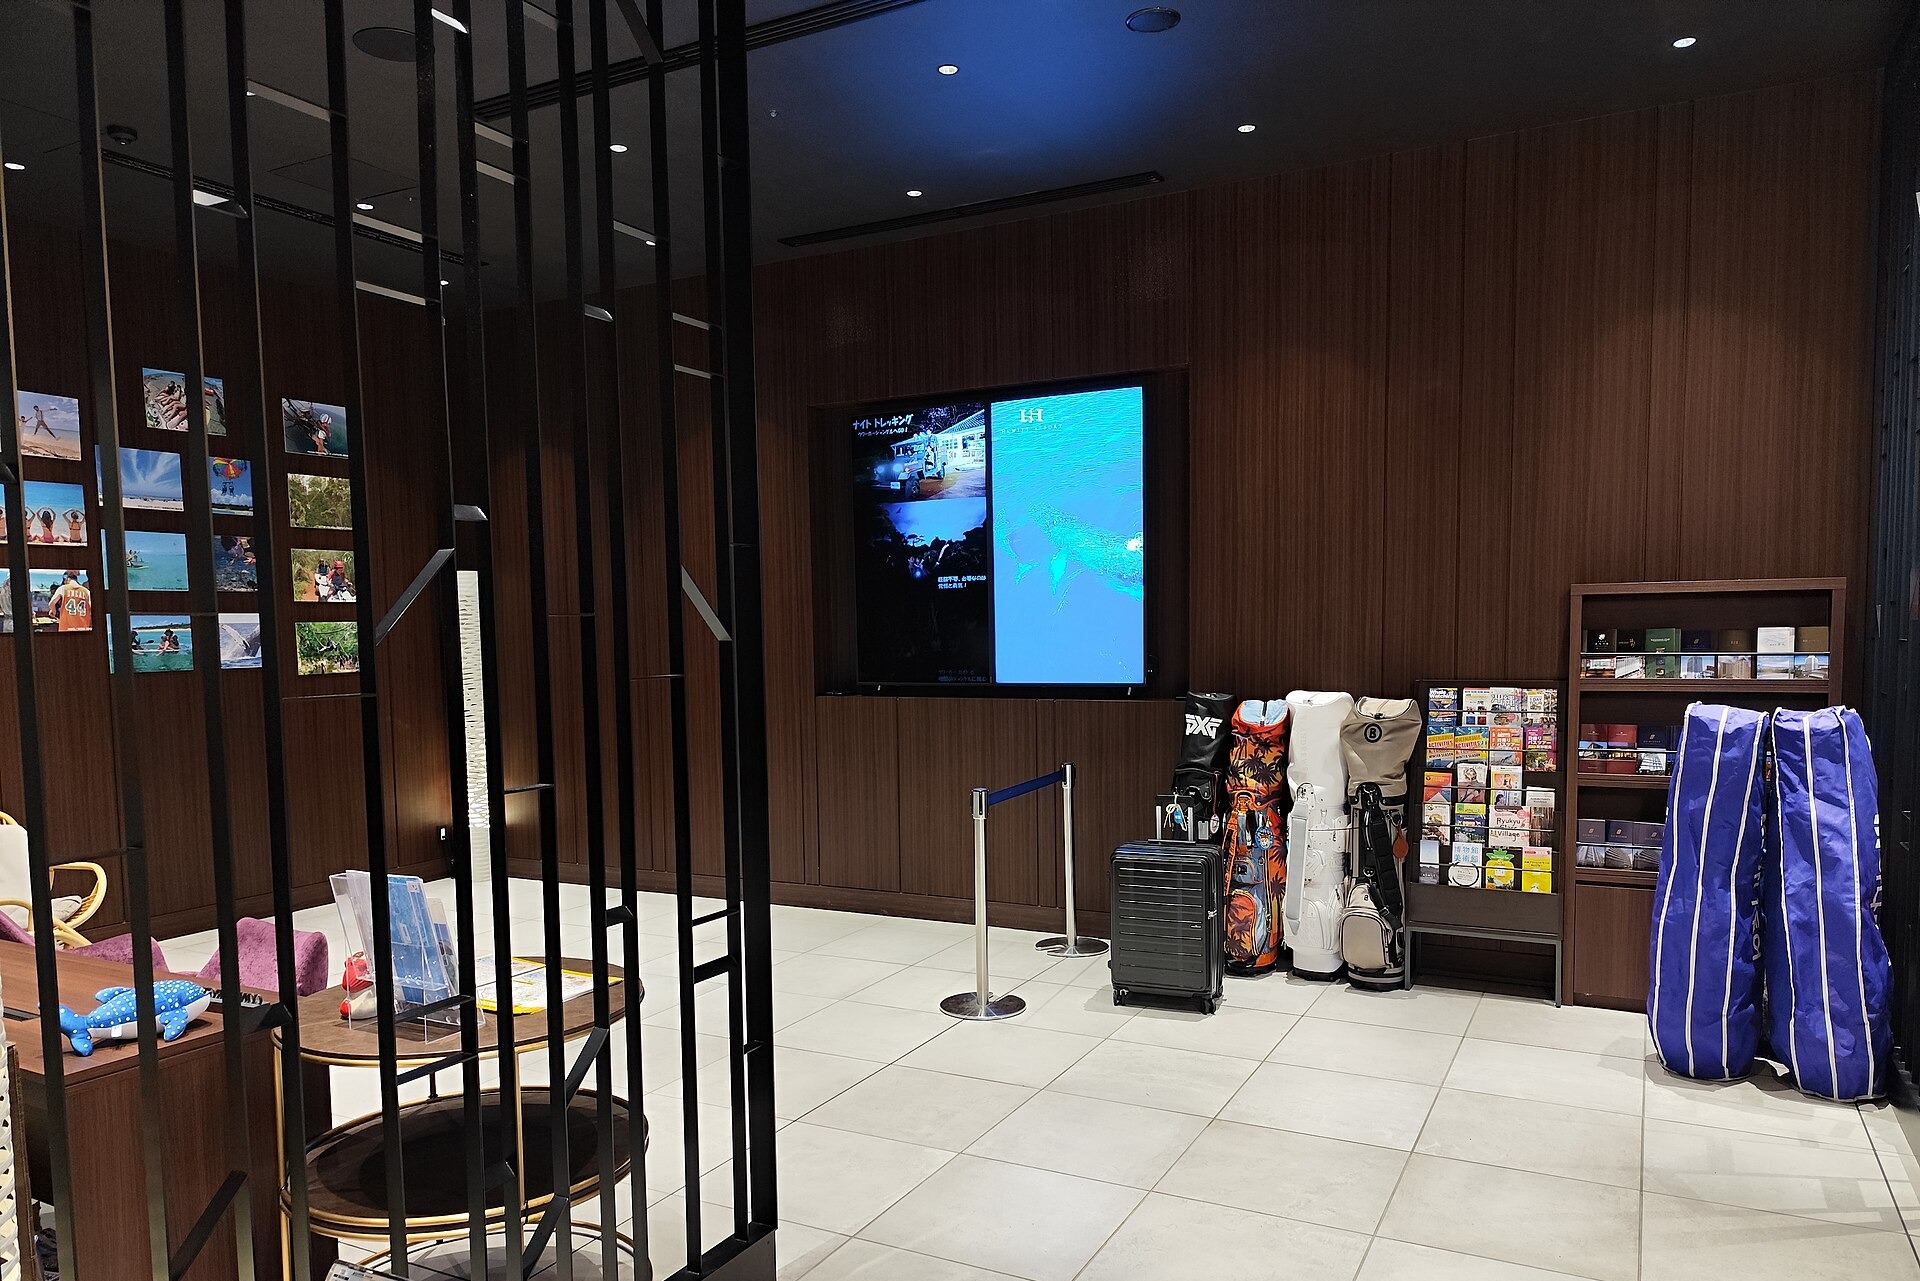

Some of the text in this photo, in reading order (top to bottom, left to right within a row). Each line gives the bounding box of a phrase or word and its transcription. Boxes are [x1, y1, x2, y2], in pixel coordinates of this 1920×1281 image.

[853, 413, 914, 430] ナイト トレッキング
[65, 598, 86, 617] 44
[1185, 713, 1223, 739] PXG
[1496, 817, 1521, 826] Ryukyu
[1497, 830, 1520, 842] Village
